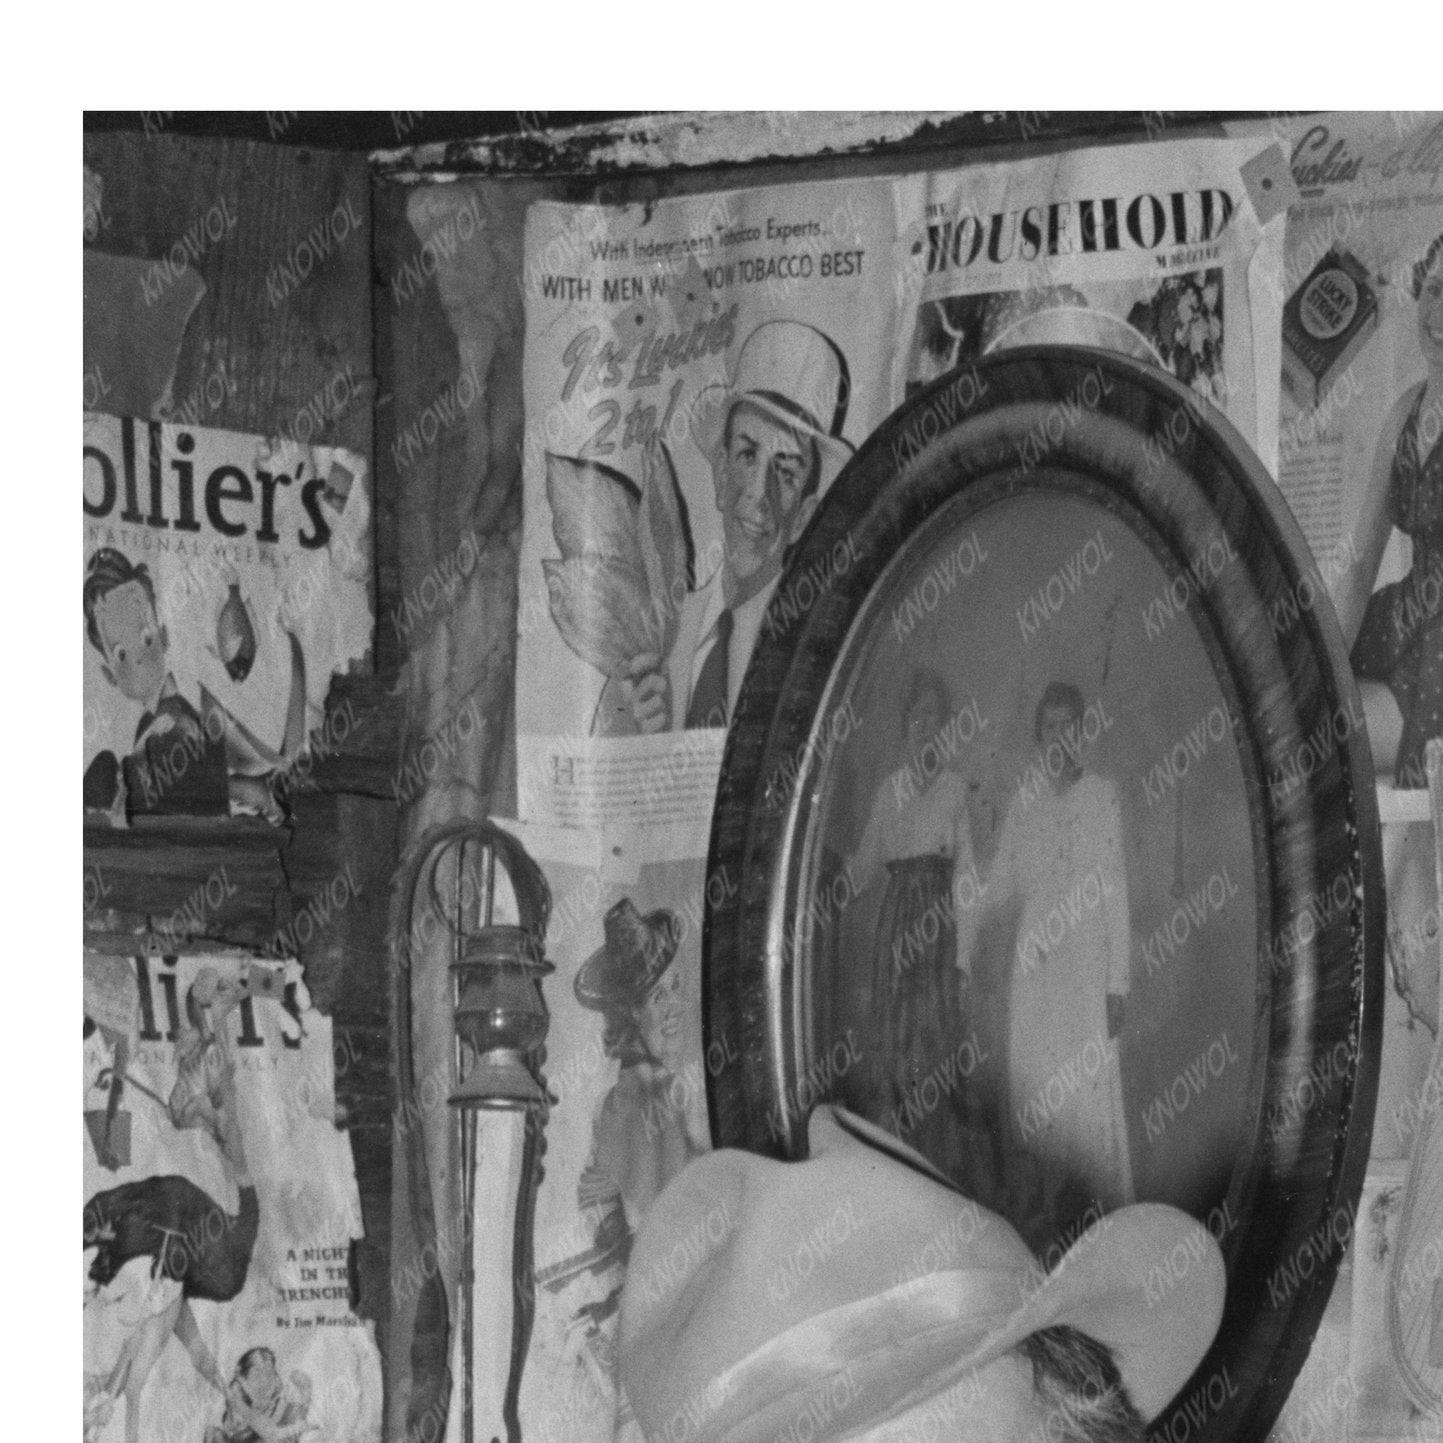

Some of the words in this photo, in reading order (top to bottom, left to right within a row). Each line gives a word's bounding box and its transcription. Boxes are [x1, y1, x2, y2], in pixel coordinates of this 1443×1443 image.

[911, 189, 1234, 275] HOUSEHOLD
[590, 240, 629, 262] With
[738, 254, 812, 286] TOBACCO
[820, 251, 864, 277] BEST
[542, 275, 591, 302] WITH
[603, 277, 643, 302] MEN
[1318, 275, 1351, 312] LUCKY
[1306, 287, 1344, 329] STRIKE
[83, 415, 334, 550] ollier's
[301, 1268, 317, 1281] IN
